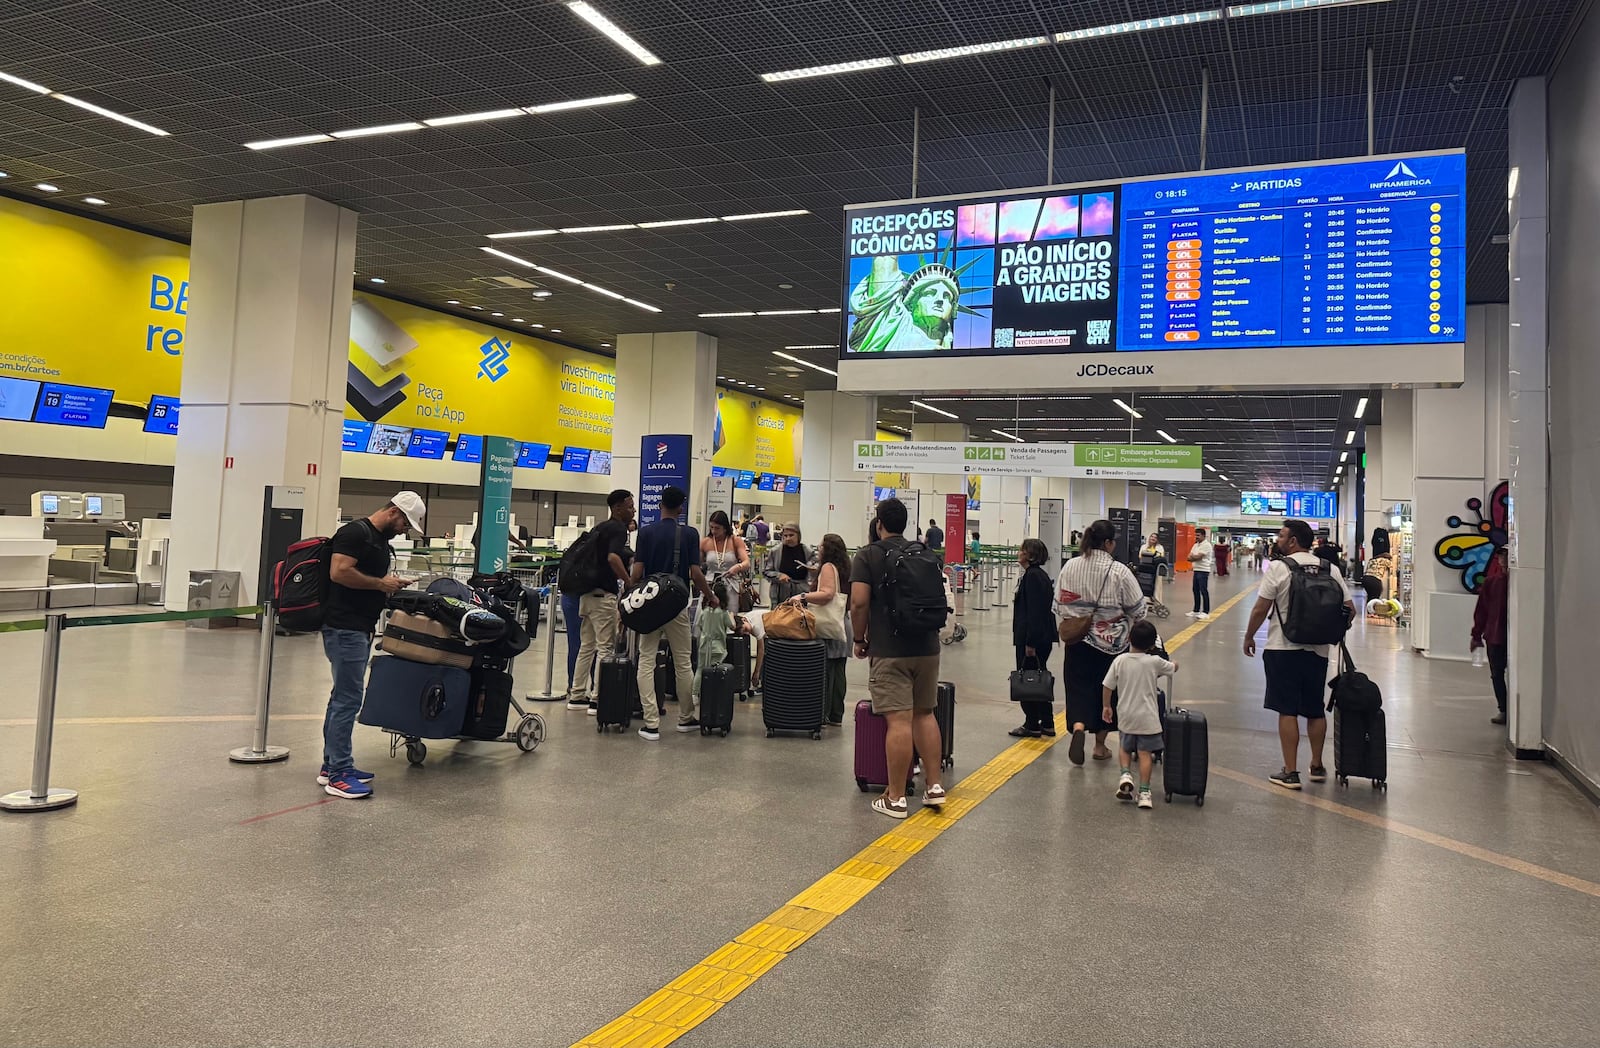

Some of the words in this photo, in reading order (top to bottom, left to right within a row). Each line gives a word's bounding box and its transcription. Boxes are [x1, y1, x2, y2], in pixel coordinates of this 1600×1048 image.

[1245, 177, 1302, 192] PARTIDAS
[1370, 179, 1431, 189] INFRAMERICA
[1166, 189, 1187, 198] 18:15
[1380, 190, 1416, 198] OBSERVAÇÃO
[852, 208, 955, 235] RECEPÇÕES
[851, 232, 936, 255] ICÔNICAS
[1001, 244, 1044, 267] DÃO
[1046, 240, 1111, 263] INÍCIO
[1356, 260, 1392, 268] Confirmado
[997, 268, 1010, 286] A
[1014, 261, 1111, 284] GRANDES
[1356, 271, 1392, 279] Confirmado
[1021, 282, 1110, 303] VIAGENS
[1087, 320, 1111, 329] NEW
[1355, 314, 1392, 322] Confirmado
[4, 353, 46, 365] condições
[1077, 364, 1154, 377] JCDecaux
[417, 383, 443, 402] Peça
[560, 378, 577, 393] vira
[579, 381, 603, 398] limite
[47, 397, 58, 406] 19
[154, 409, 166, 417] 20
[416, 404, 432, 417] no
[442, 405, 465, 424] App
[559, 404, 583, 417] Resolve
[589, 411, 598, 420] sua
[558, 418, 573, 428] mais
[593, 425, 603, 434] pra
[757, 415, 777, 429] Cartões
[1120, 449, 1153, 457] Embarque
[1154, 449, 1191, 457] Doméstico
[642, 484, 662, 493] Entrega
